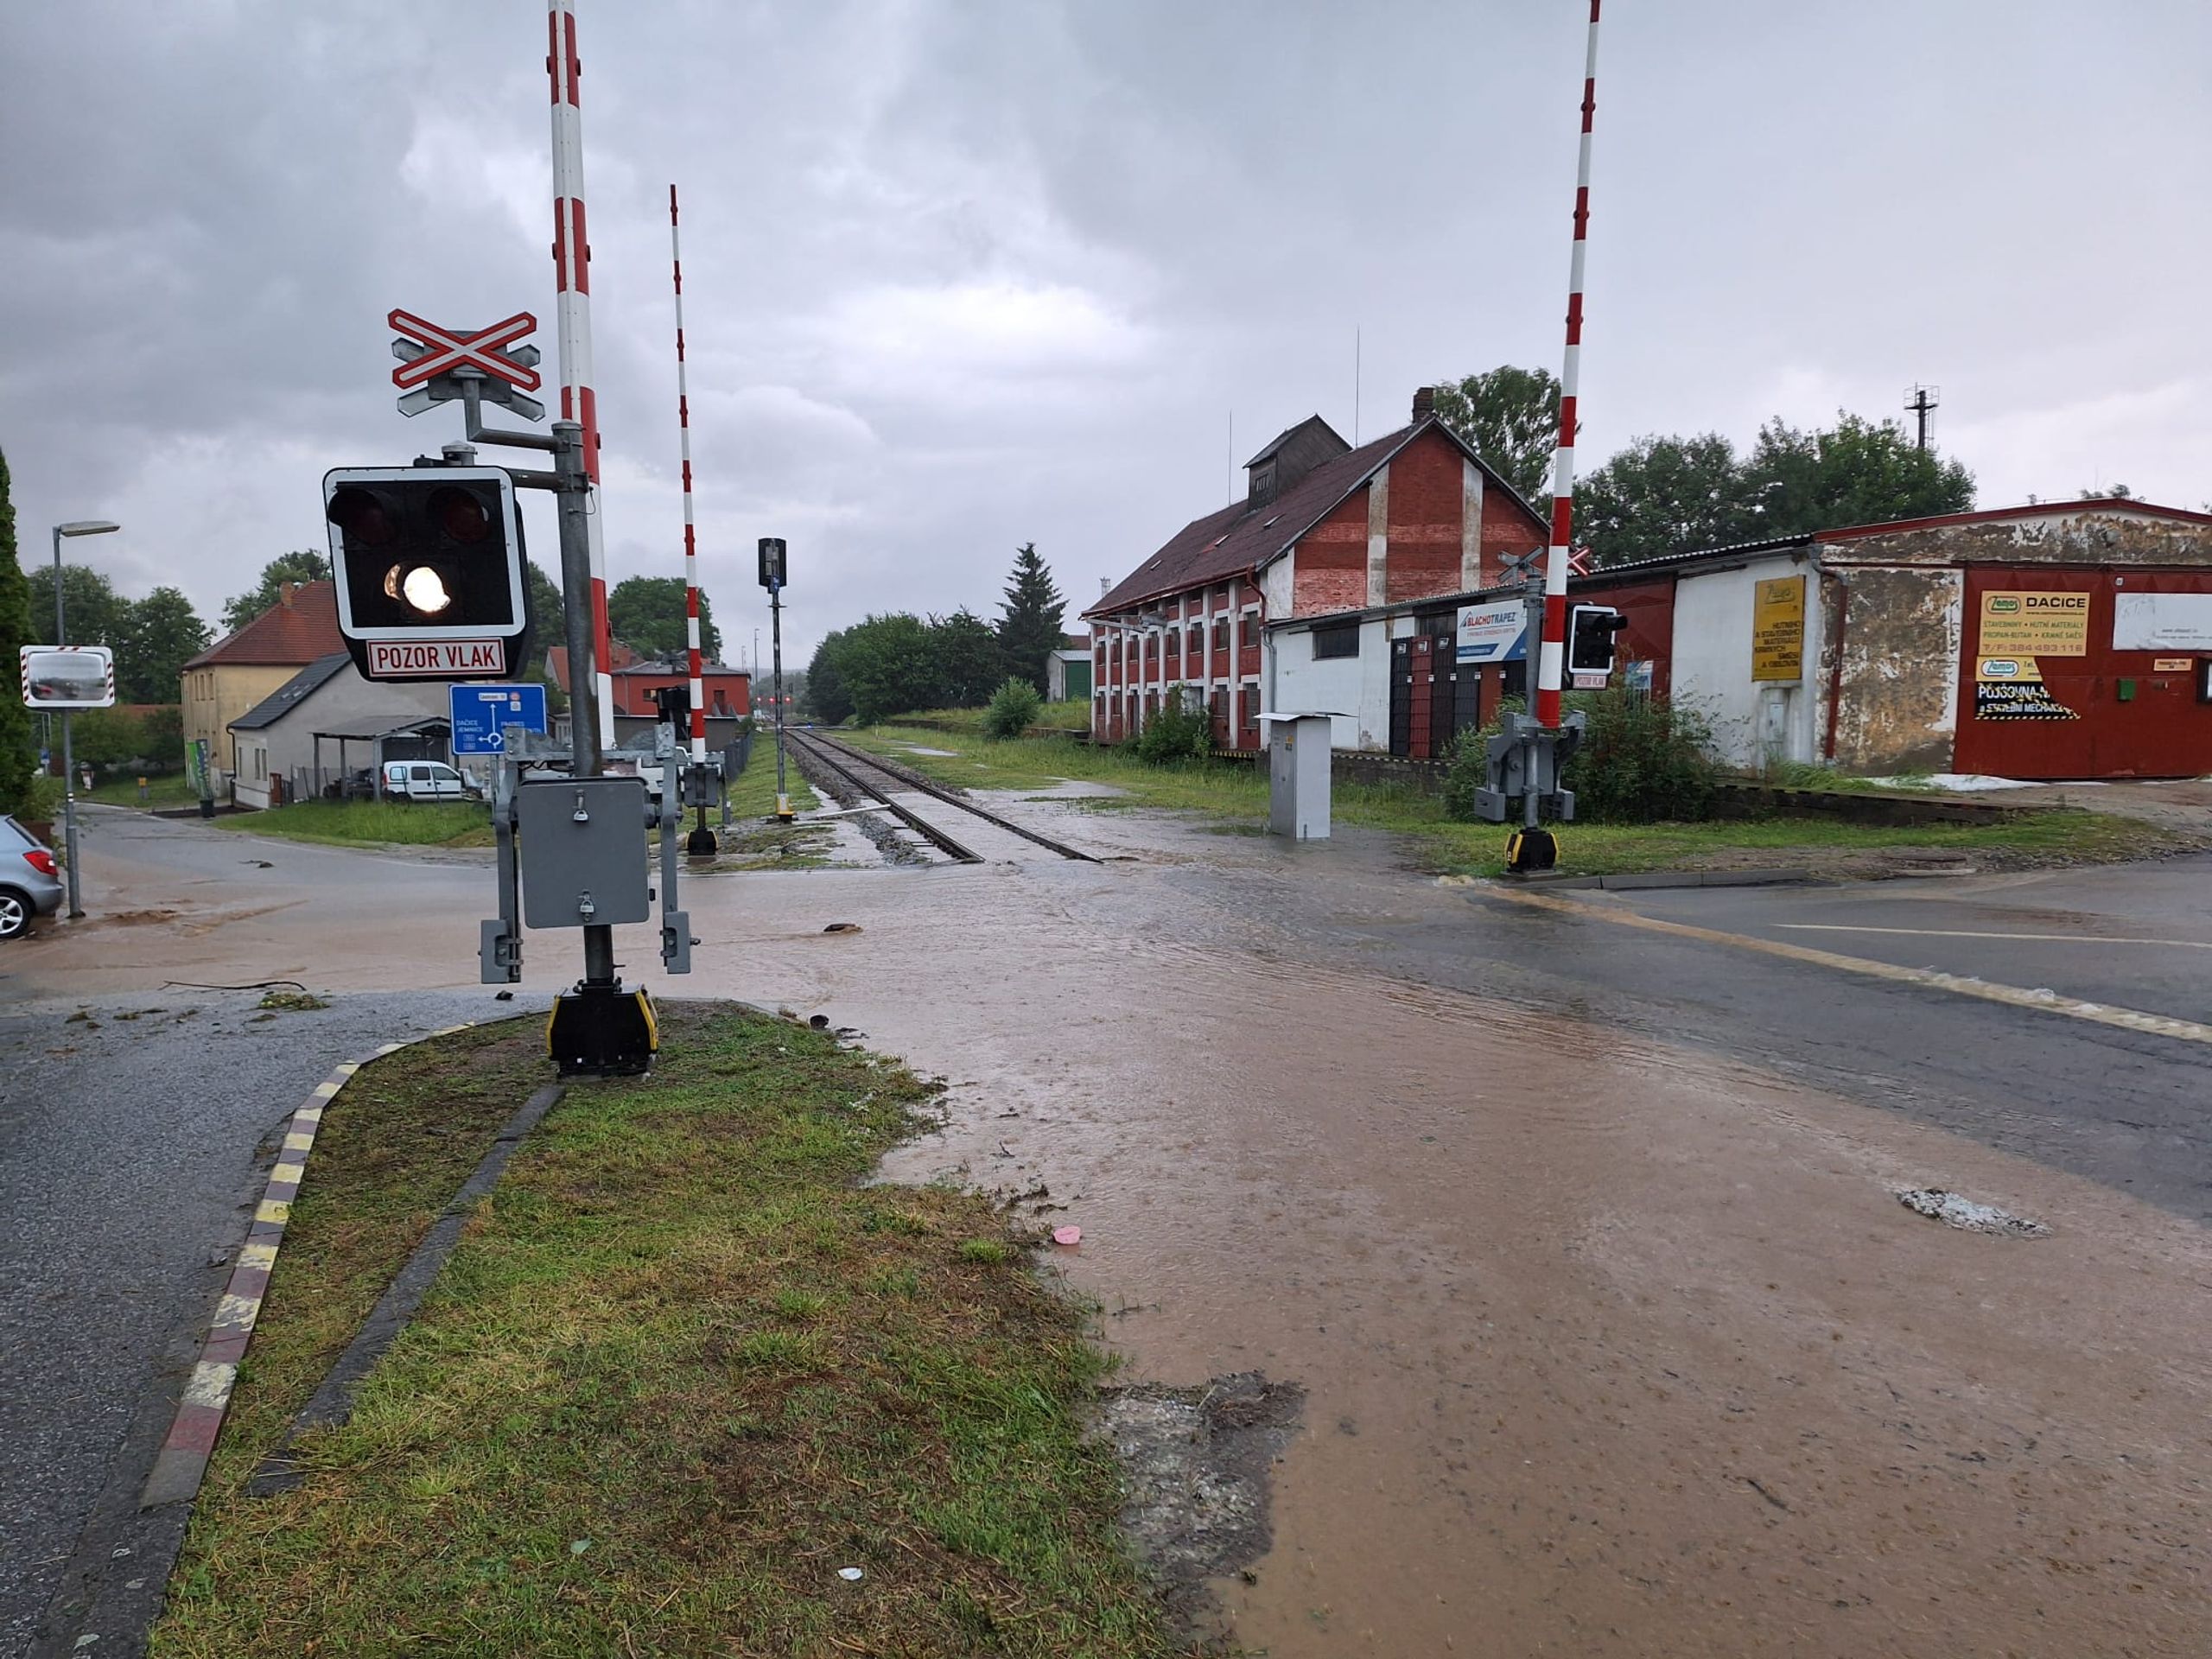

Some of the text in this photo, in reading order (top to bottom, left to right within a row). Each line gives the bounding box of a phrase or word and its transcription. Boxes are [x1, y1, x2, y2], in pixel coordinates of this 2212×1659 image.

[1466, 612, 1516, 626] BLACHOTRAPEZ
[378, 645, 496, 669] POZOR VLAK
